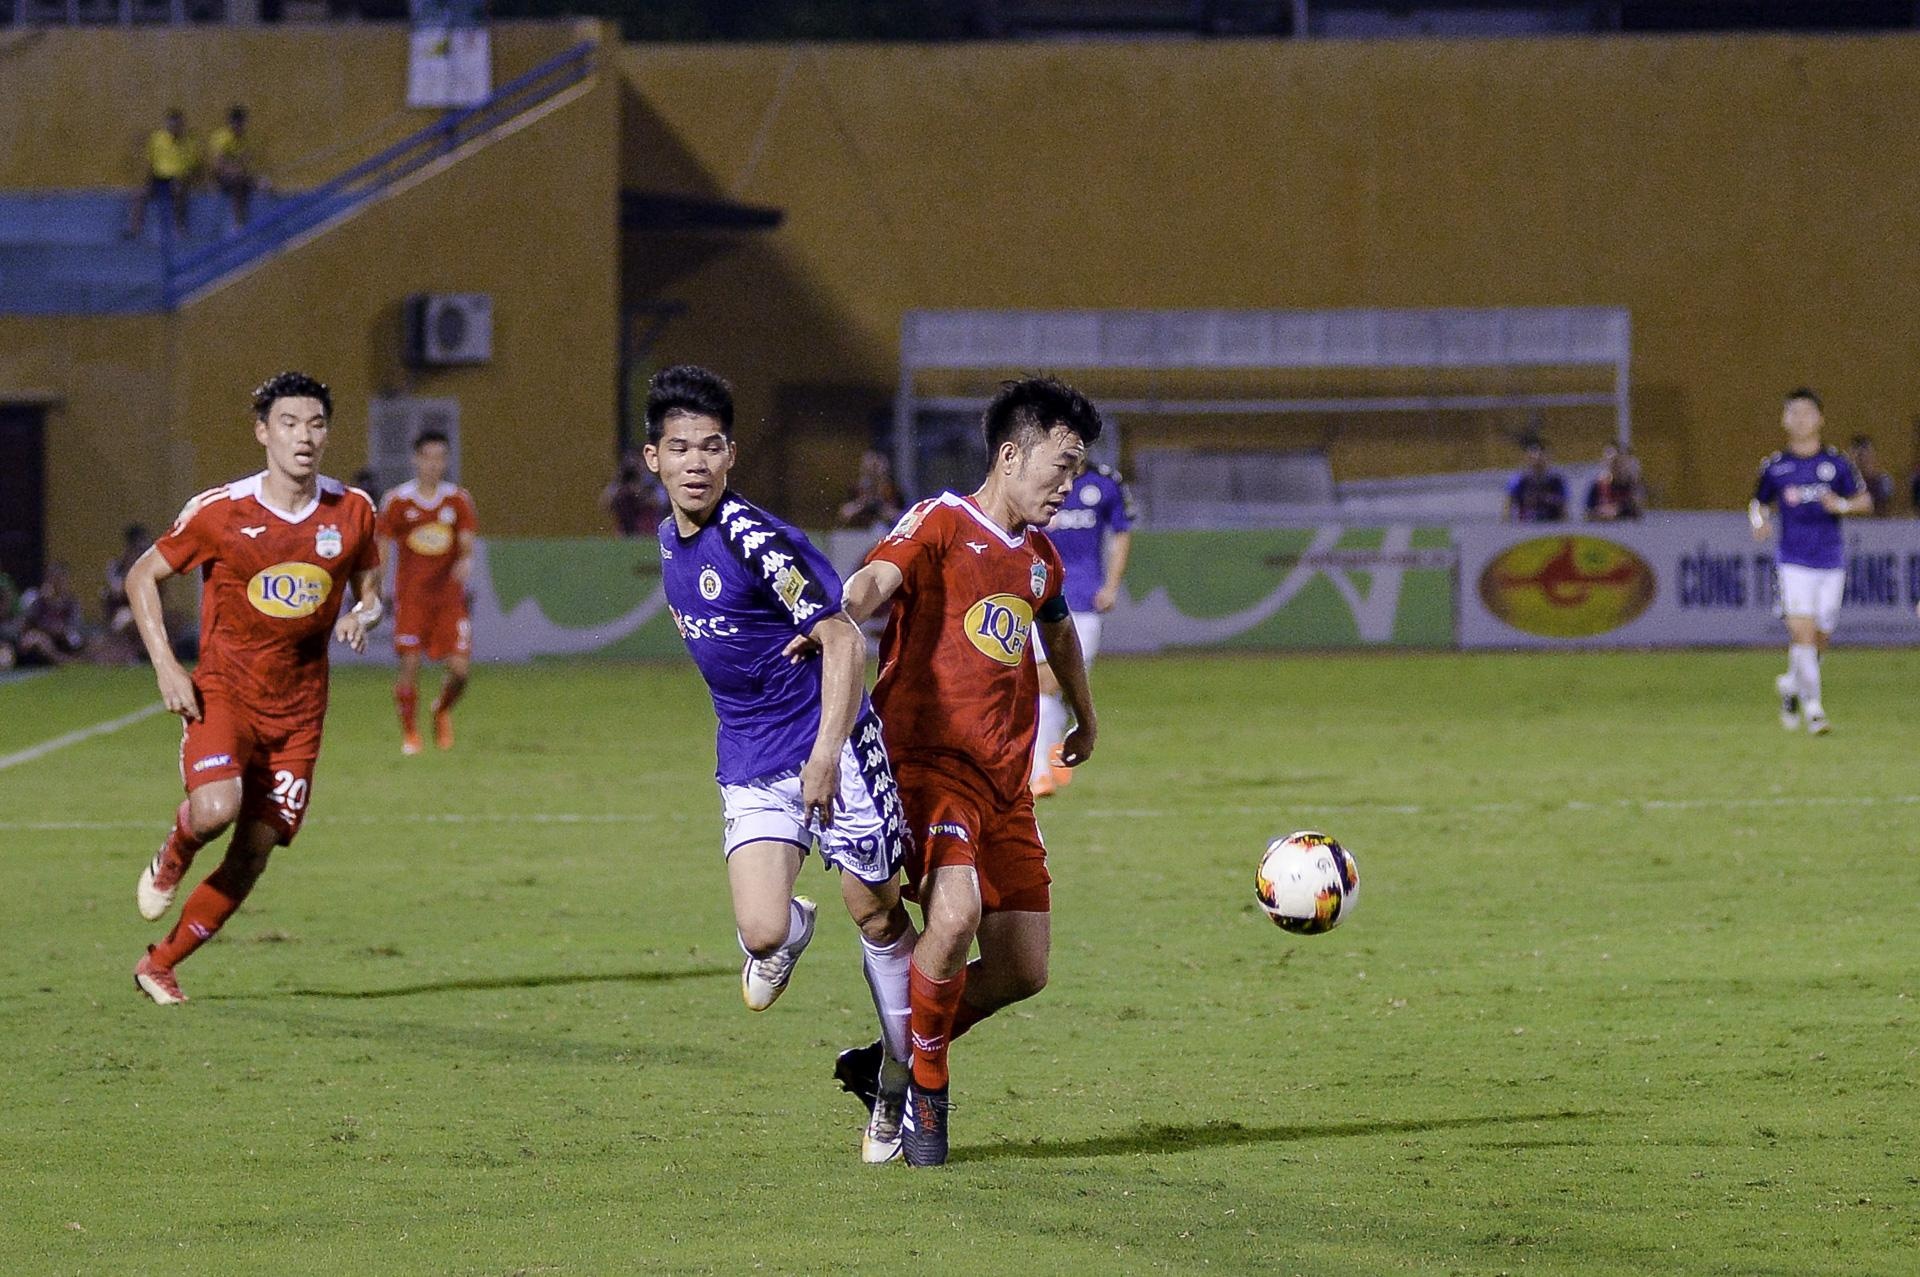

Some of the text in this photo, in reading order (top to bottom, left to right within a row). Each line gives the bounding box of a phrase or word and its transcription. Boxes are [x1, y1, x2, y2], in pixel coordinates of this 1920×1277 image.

[262, 575, 300, 608] IQ
[977, 601, 1014, 655] IQ
[267, 770, 308, 811] 20
